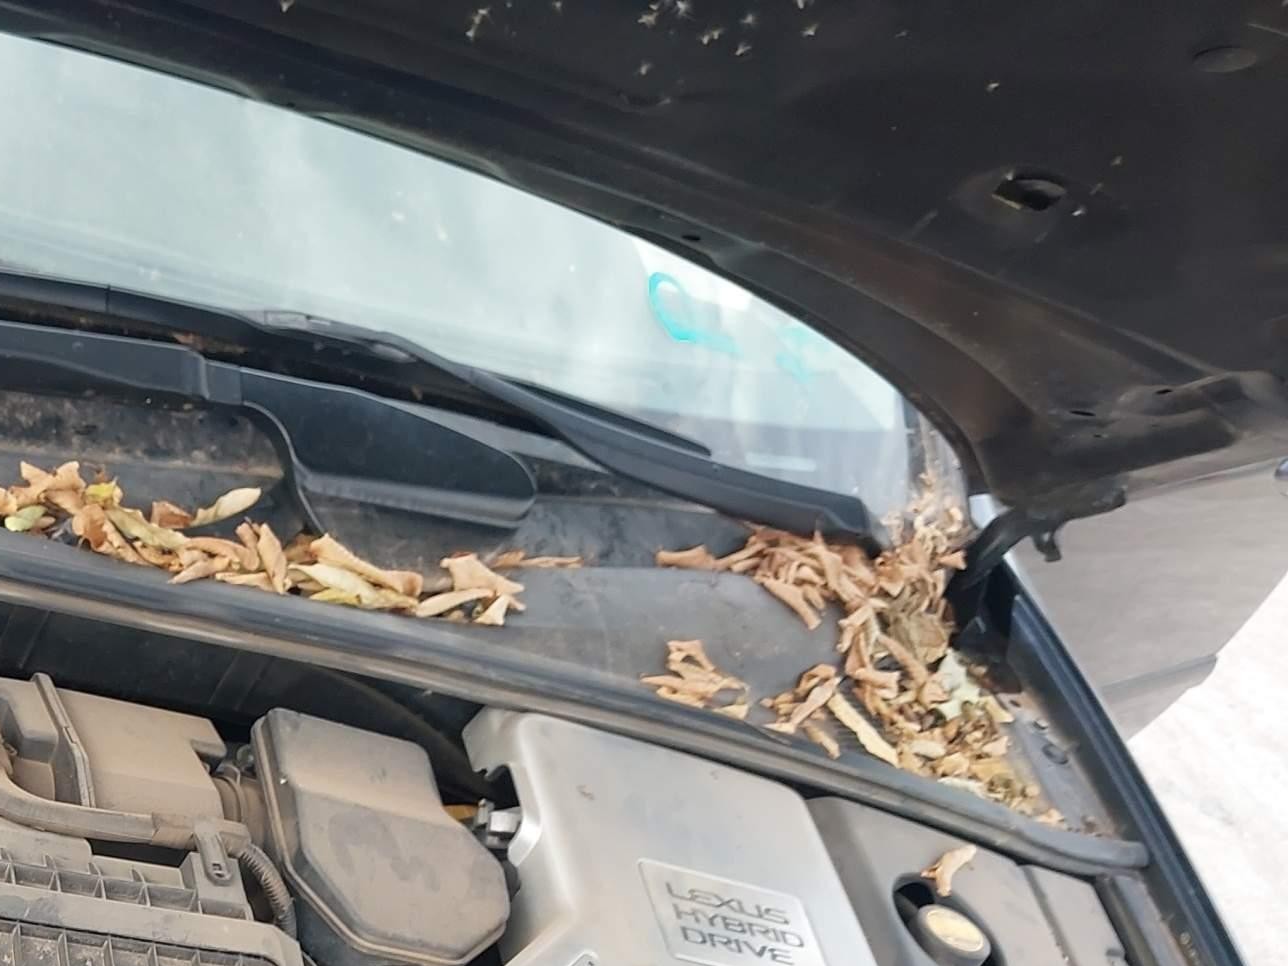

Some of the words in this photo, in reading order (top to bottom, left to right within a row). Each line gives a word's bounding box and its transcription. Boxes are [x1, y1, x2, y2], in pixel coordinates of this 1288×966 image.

[665, 881, 790, 926] LEXUS
[672, 902, 805, 948] HYBRID
[680, 925, 795, 966] DRIVE
